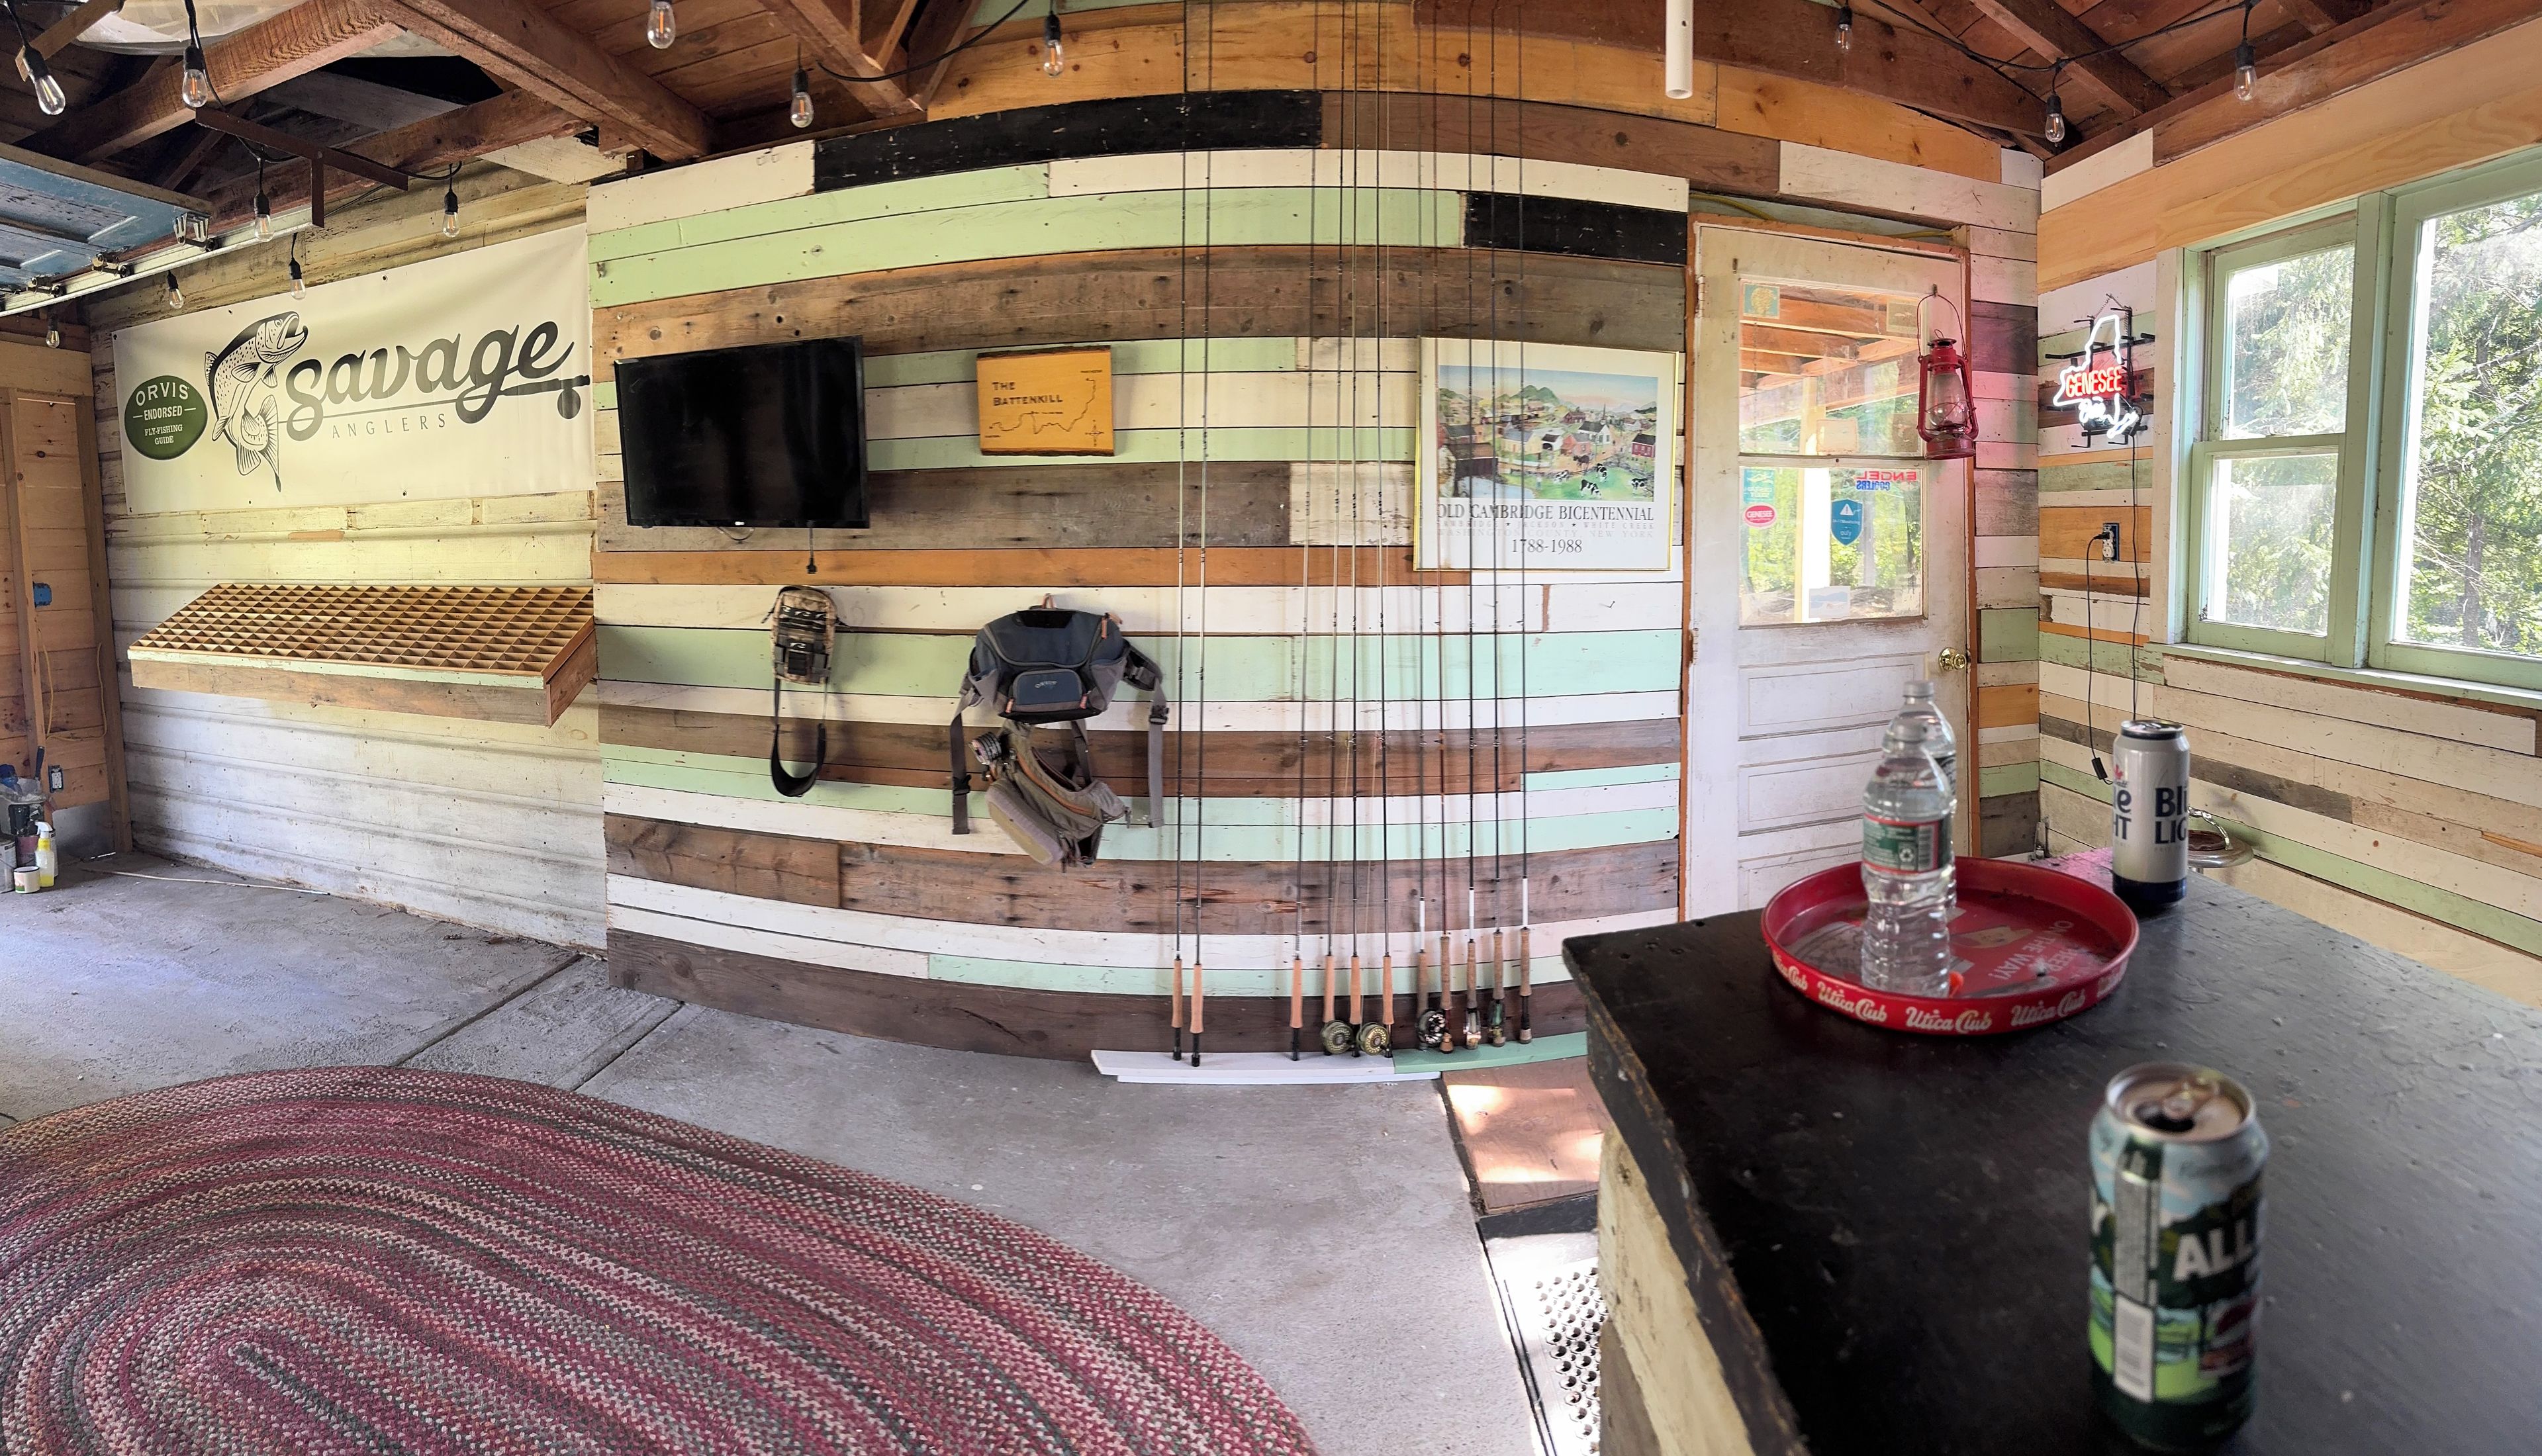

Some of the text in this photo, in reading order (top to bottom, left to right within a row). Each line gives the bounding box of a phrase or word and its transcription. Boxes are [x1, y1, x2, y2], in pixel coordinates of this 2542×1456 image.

[992, 381, 1015, 390] THE
[2065, 365, 2123, 398] GENESEE
[136, 382, 189, 406] ORVIS
[993, 394, 1063, 406] BATTENKILL
[144, 405, 183, 421] ENDORSED
[144, 424, 183, 436] FLY-FISHING
[332, 413, 446, 439] ANGLERS
[154, 435, 174, 445] GUIDE
[1559, 506, 1654, 521] BICENTENNIAL
[1817, 981, 1887, 1023] Utica Club
[2010, 989, 2086, 1026] Utica Club
[1905, 1006, 1992, 1034] Utica Club
